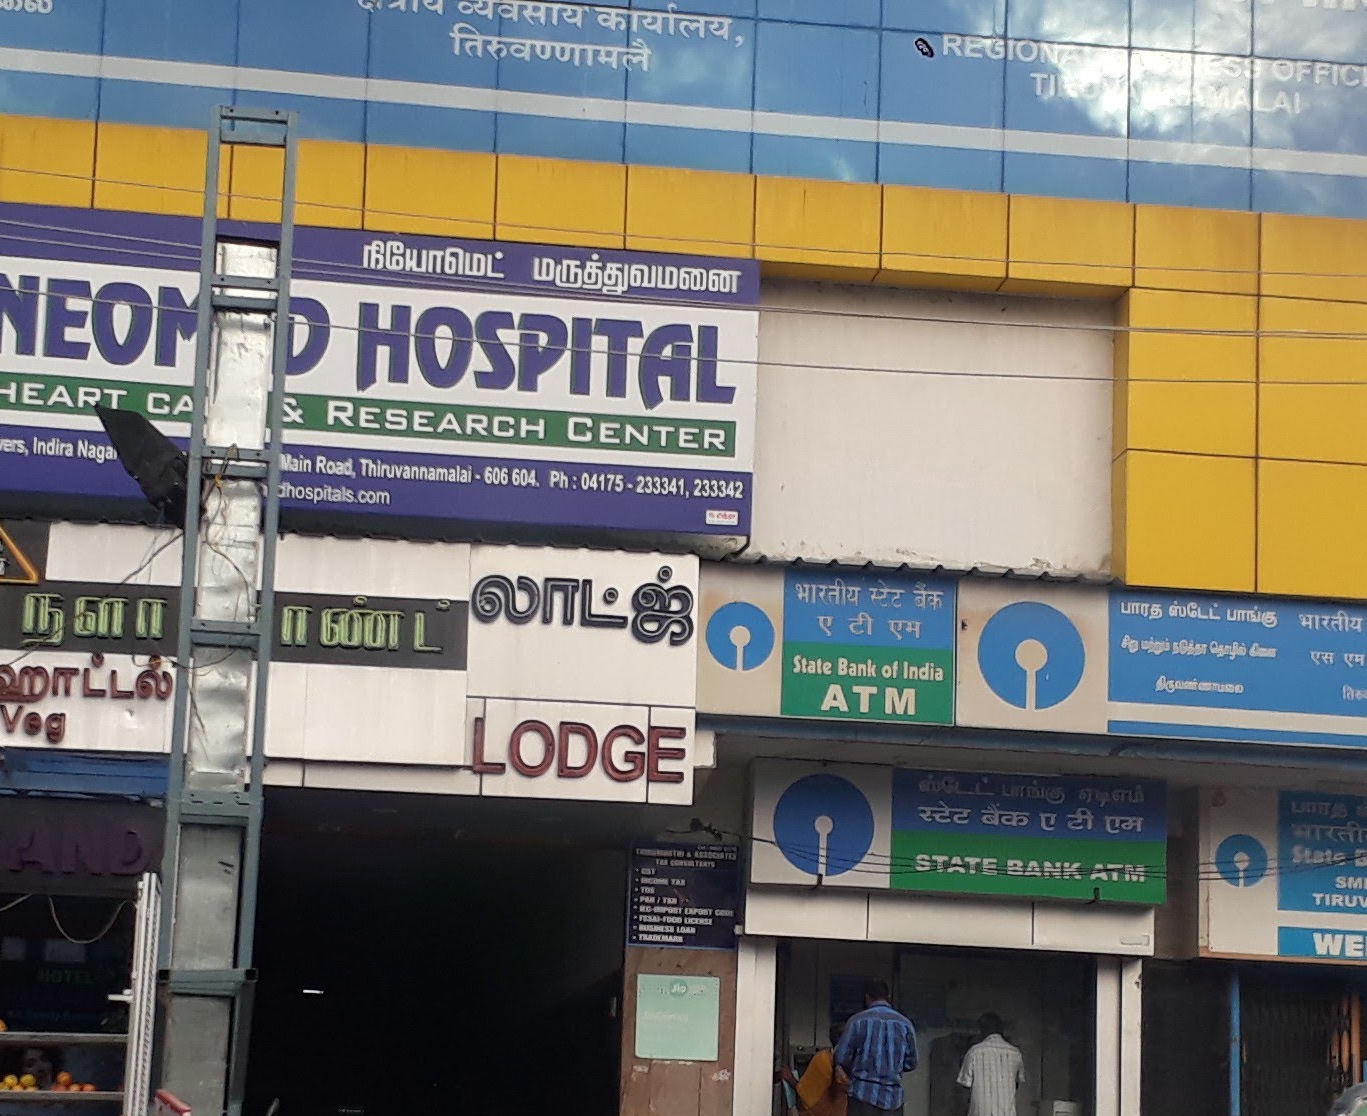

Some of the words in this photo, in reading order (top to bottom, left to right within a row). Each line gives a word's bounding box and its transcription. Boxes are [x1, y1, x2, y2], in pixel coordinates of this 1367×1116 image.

[363, 240, 505, 279] நியோமெட்
[533, 254, 743, 295] மருத்துவமனை
[355, 301, 737, 409] HOSPITAL
[146, 391, 194, 416] CA
[283, 397, 305, 424] &
[327, 399, 546, 440] RESEARCH
[567, 417, 727, 451] CENTER
[33, 437, 74, 458] Indira
[316, 456, 356, 479] Road,
[360, 458, 472, 484] Thiruvannamalai
[484, 469, 509, 486] 606
[549, 471, 569, 490] Ph
[581, 473, 624, 492] 04175
[636, 477, 690, 499] 233341,
[693, 481, 743, 499] 233342
[472, 565, 695, 646] லாட்ஜ்
[795, 578, 861, 607] भारतीय
[868, 579, 905, 609] स्टेट
[913, 581, 944, 610] बैंक
[817, 615, 833, 636] ए
[847, 612, 873, 636] टी
[888, 620, 921, 640] एम
[1120, 601, 1163, 619] பாரத
[1168, 600, 1221, 620] ஸ்டேட்
[1227, 605, 1278, 628] பாங்கு
[1298, 609, 1363, 633] भारतीय
[793, 655, 832, 675] State
[838, 657, 876, 678] Bank
[881, 661, 898, 679] of
[903, 661, 944, 681] India
[820, 684, 916, 715] ATM
[471, 717, 687, 785] LODGE
[1001, 780, 1066, 804] பாங்கு
[917, 800, 971, 825] स्टेट
[981, 802, 1030, 827] बैंक
[1039, 812, 1057, 831] ए
[1067, 807, 1094, 830] टी
[1105, 815, 1144, 834] एम
[915, 854, 998, 875] STATE
[1007, 859, 1082, 880] BANK
[1090, 863, 1146, 883] ATM
[1293, 845, 1346, 866] State
[1335, 875, 1367, 891] SM
